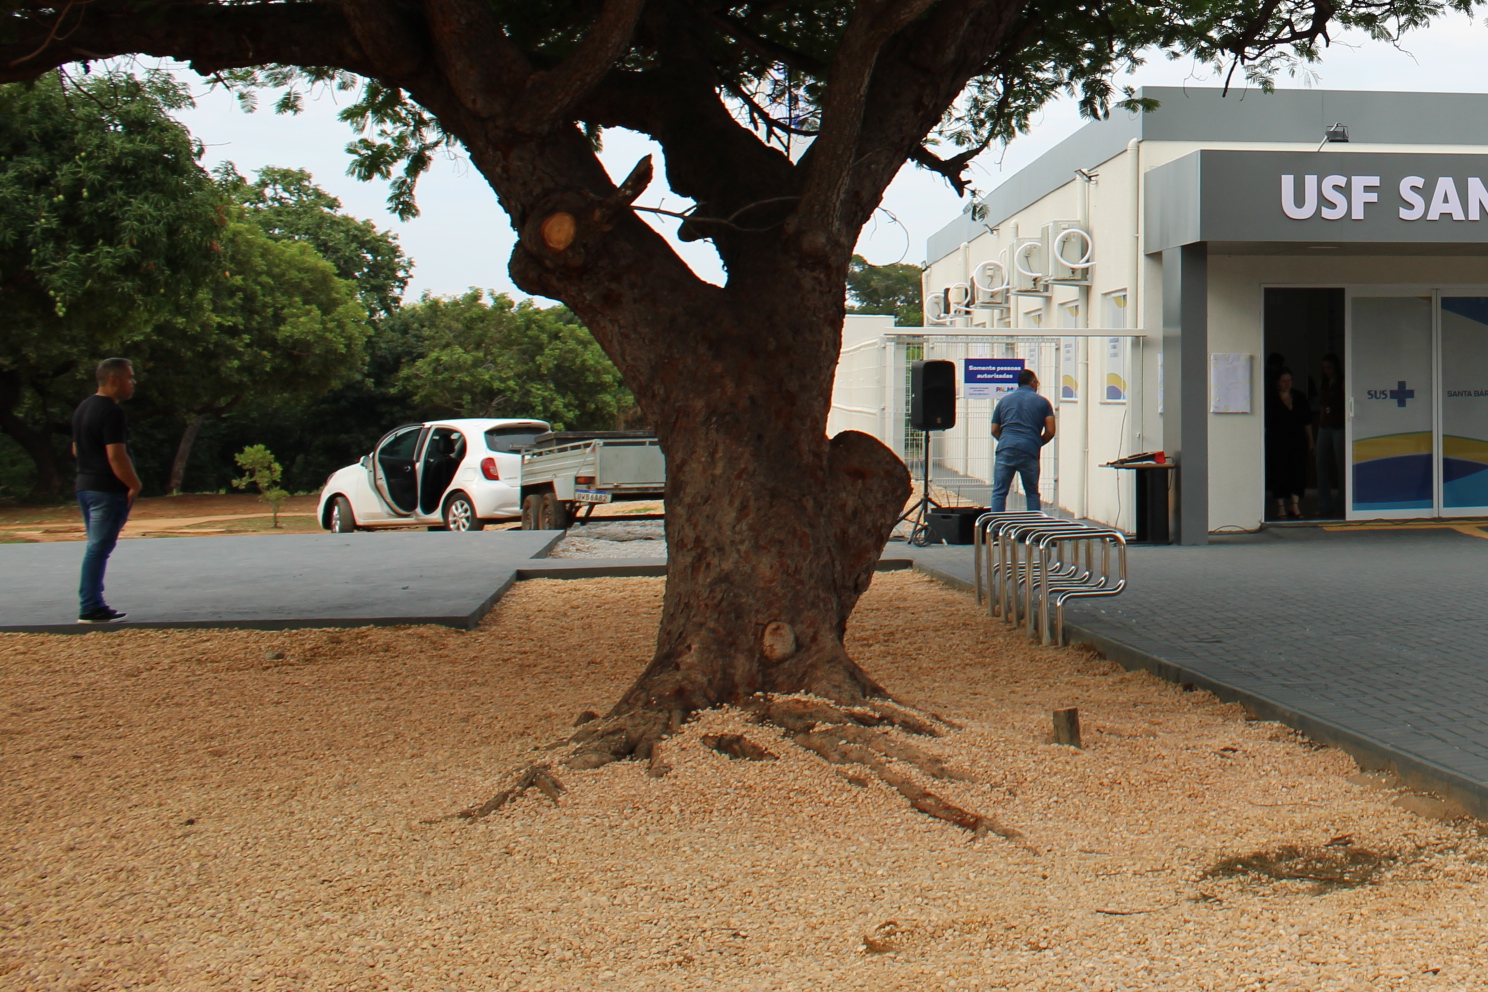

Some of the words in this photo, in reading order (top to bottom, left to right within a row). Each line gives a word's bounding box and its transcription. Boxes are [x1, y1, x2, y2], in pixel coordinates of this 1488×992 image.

[1281, 174, 1380, 220] USF
[1366, 389, 1388, 400] SUS
[1446, 390, 1473, 398] SANTA
